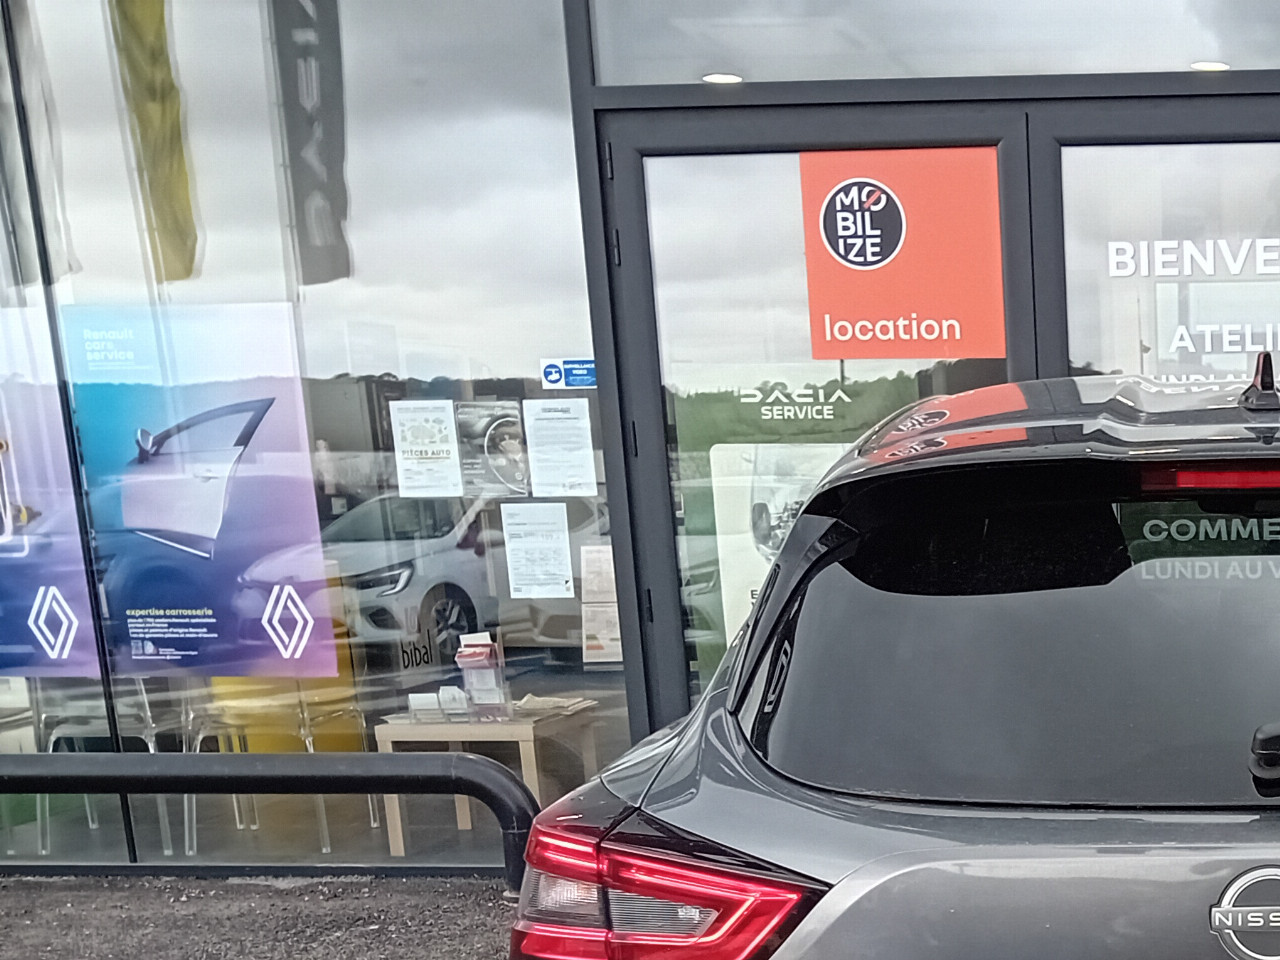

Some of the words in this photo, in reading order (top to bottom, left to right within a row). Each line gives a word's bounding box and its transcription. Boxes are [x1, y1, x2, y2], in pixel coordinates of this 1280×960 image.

[83, 327, 134, 340] Renault
[824, 313, 961, 341] location
[86, 350, 135, 360] service
[740, 389, 852, 403] DACIA
[760, 405, 834, 420] SERVICE
[1141, 561, 1219, 580] LUNDI
[1226, 560, 1262, 580] AU
[126, 608, 165, 617] expertise
[165, 608, 213, 616] carrosserie
[401, 629, 433, 669] bibal
